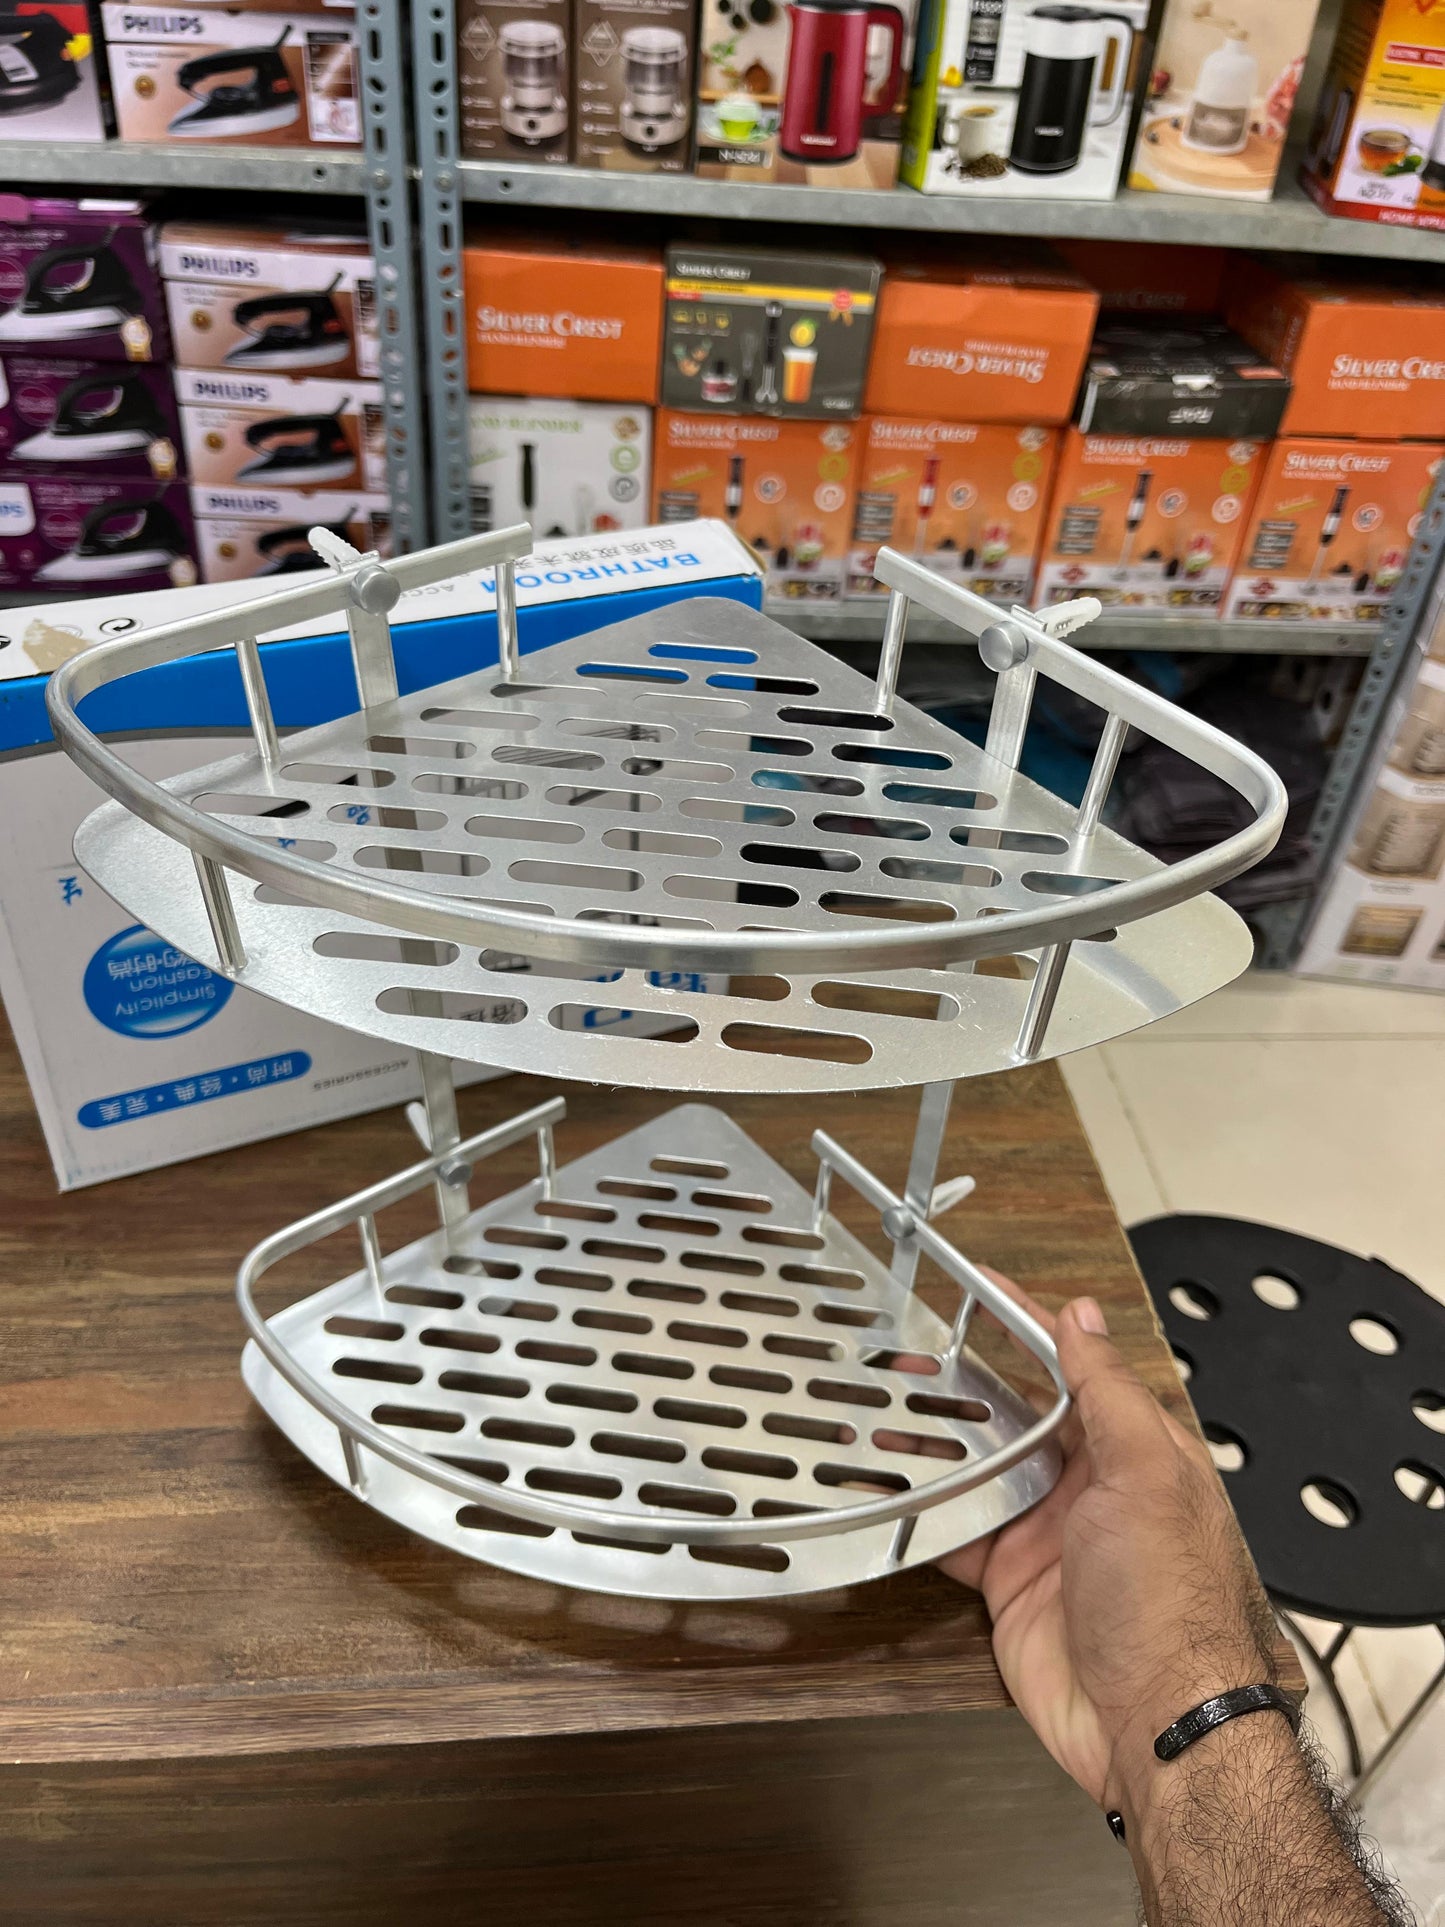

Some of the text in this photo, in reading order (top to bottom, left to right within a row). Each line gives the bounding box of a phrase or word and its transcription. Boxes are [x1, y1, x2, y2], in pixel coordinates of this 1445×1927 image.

[123, 14, 204, 35] PHILIPS
[180, 254, 260, 278] PHILIPS
[194, 380, 271, 402] PHILIPS
[208, 493, 281, 514] PHILIPS
[114, 982, 217, 1017] Simplicity
[312, 1059, 409, 1092] ACCESSORIES
